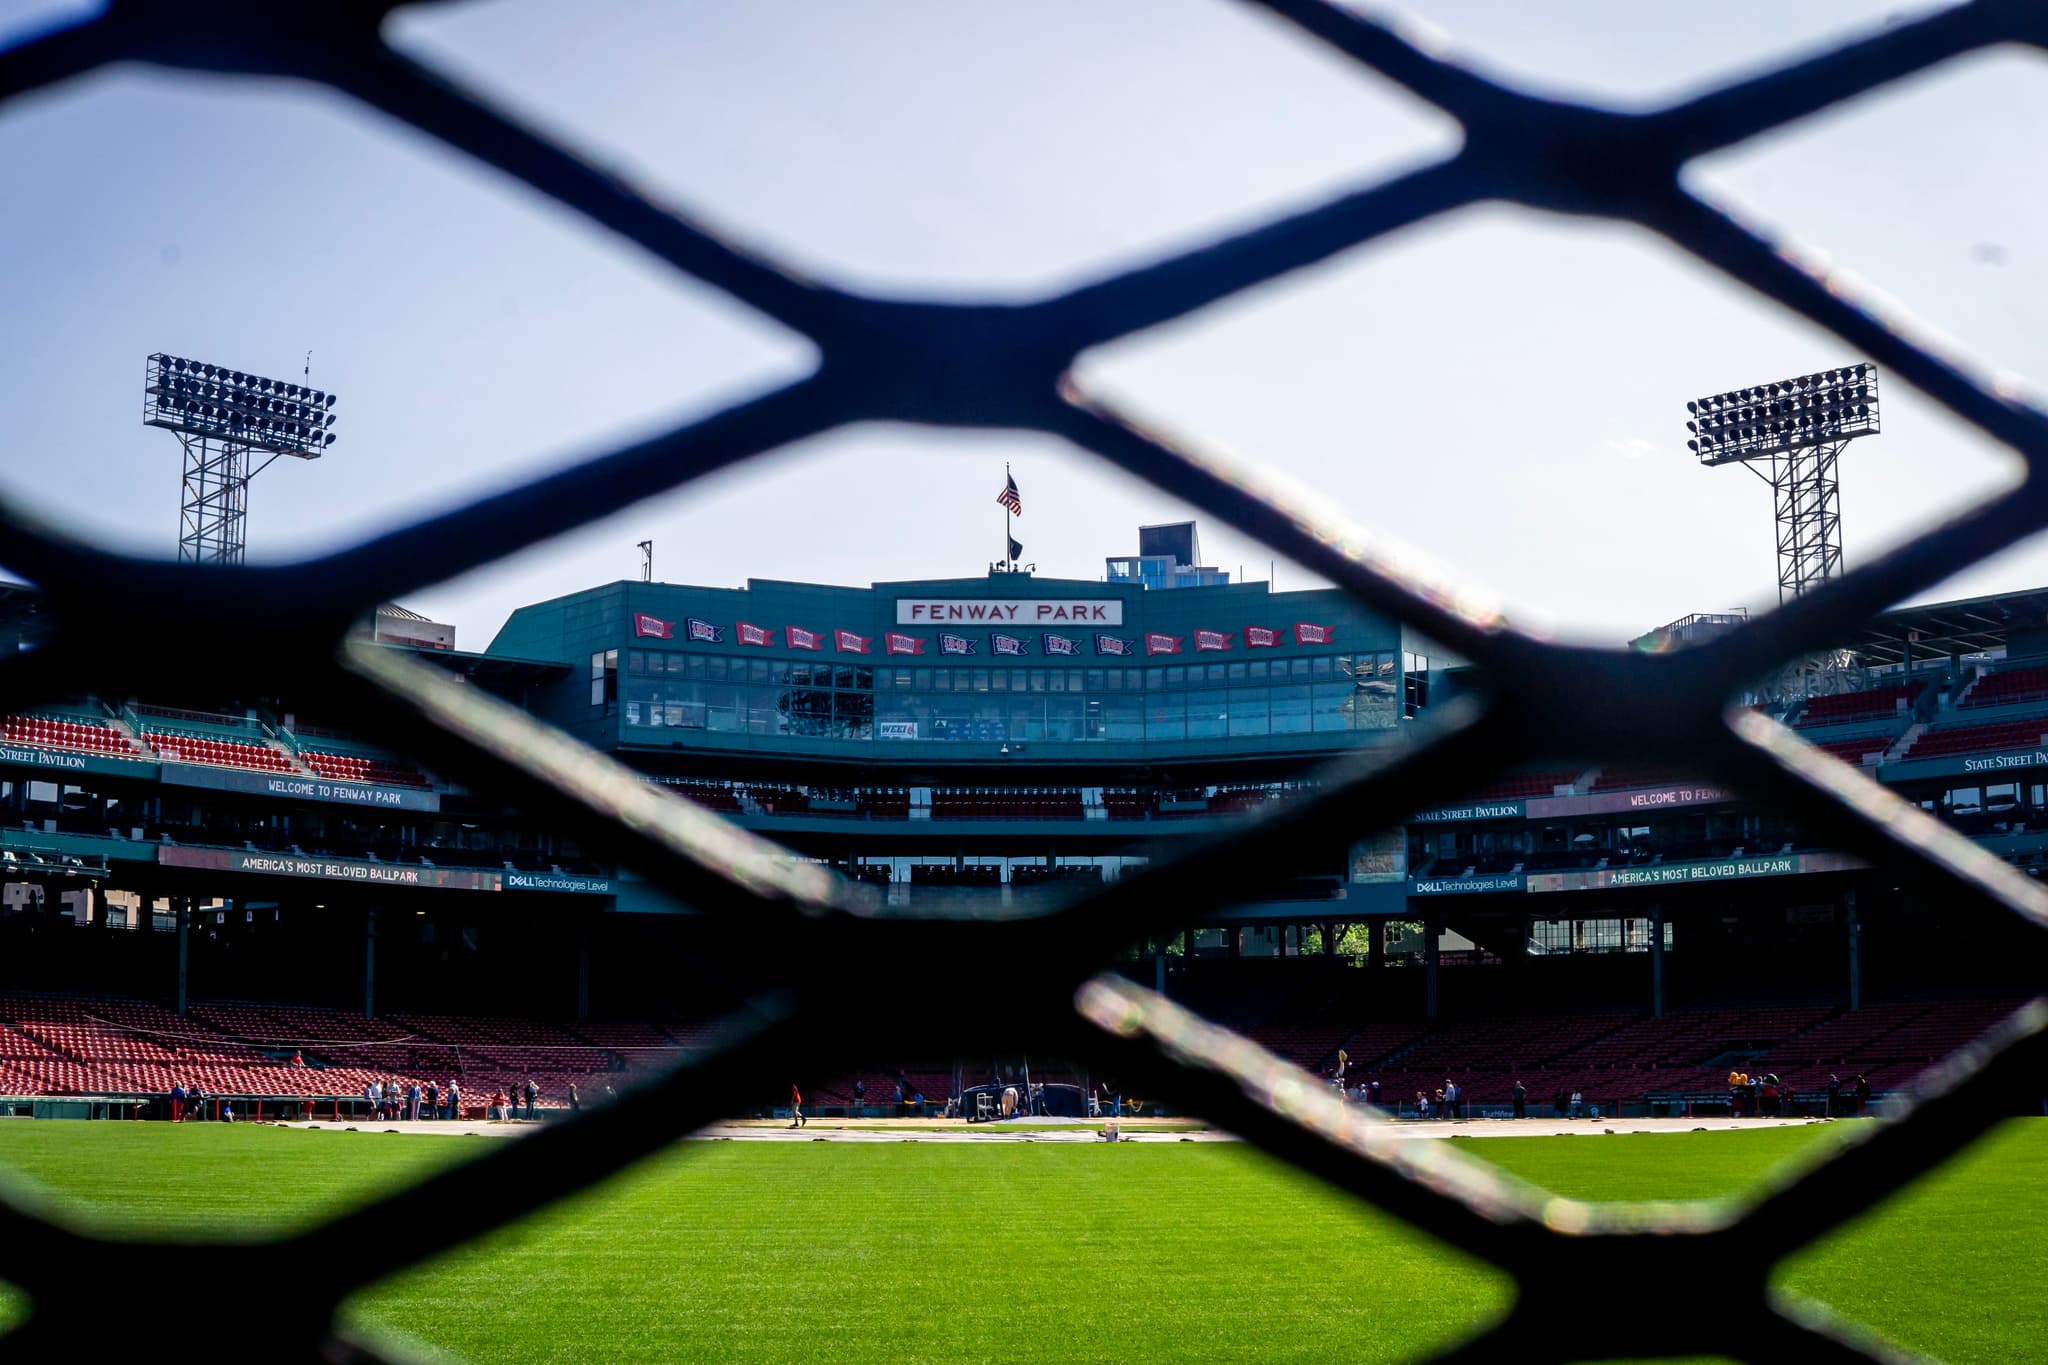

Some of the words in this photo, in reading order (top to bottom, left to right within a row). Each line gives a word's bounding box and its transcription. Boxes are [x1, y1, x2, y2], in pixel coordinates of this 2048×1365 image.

[912, 604, 1019, 620] FENWAY
[1037, 605, 1107, 620] PARK
[881, 725, 906, 734] WEEI
[38, 751, 86, 768] PAVILION
[1965, 758, 1995, 771] STATE
[1996, 754, 2032, 768] STREET
[268, 780, 315, 795] WELCOME
[318, 785, 331, 797] TO
[333, 787, 374, 801] FENWAY
[375, 791, 401, 804] PARK
[1631, 791, 1677, 806] WELCOME
[1680, 790, 1692, 801] TO
[1695, 787, 1735, 801] FENW
[1415, 809, 1440, 822] STATE
[1441, 808, 1472, 820] STREET
[1475, 805, 1518, 818] PAVILION
[242, 857, 293, 872] AMERICA'S
[296, 862, 322, 875] MOST
[325, 864, 367, 878] BELOVED
[370, 868, 418, 882] BALLPARK
[1611, 870, 1659, 884] AMERICA'S
[1662, 868, 1688, 881] MOST
[1691, 864, 1735, 879] BELOVED
[1738, 860, 1792, 874] BALLPARK
[587, 880, 608, 891] Level
[1496, 877, 1518, 889] Level
